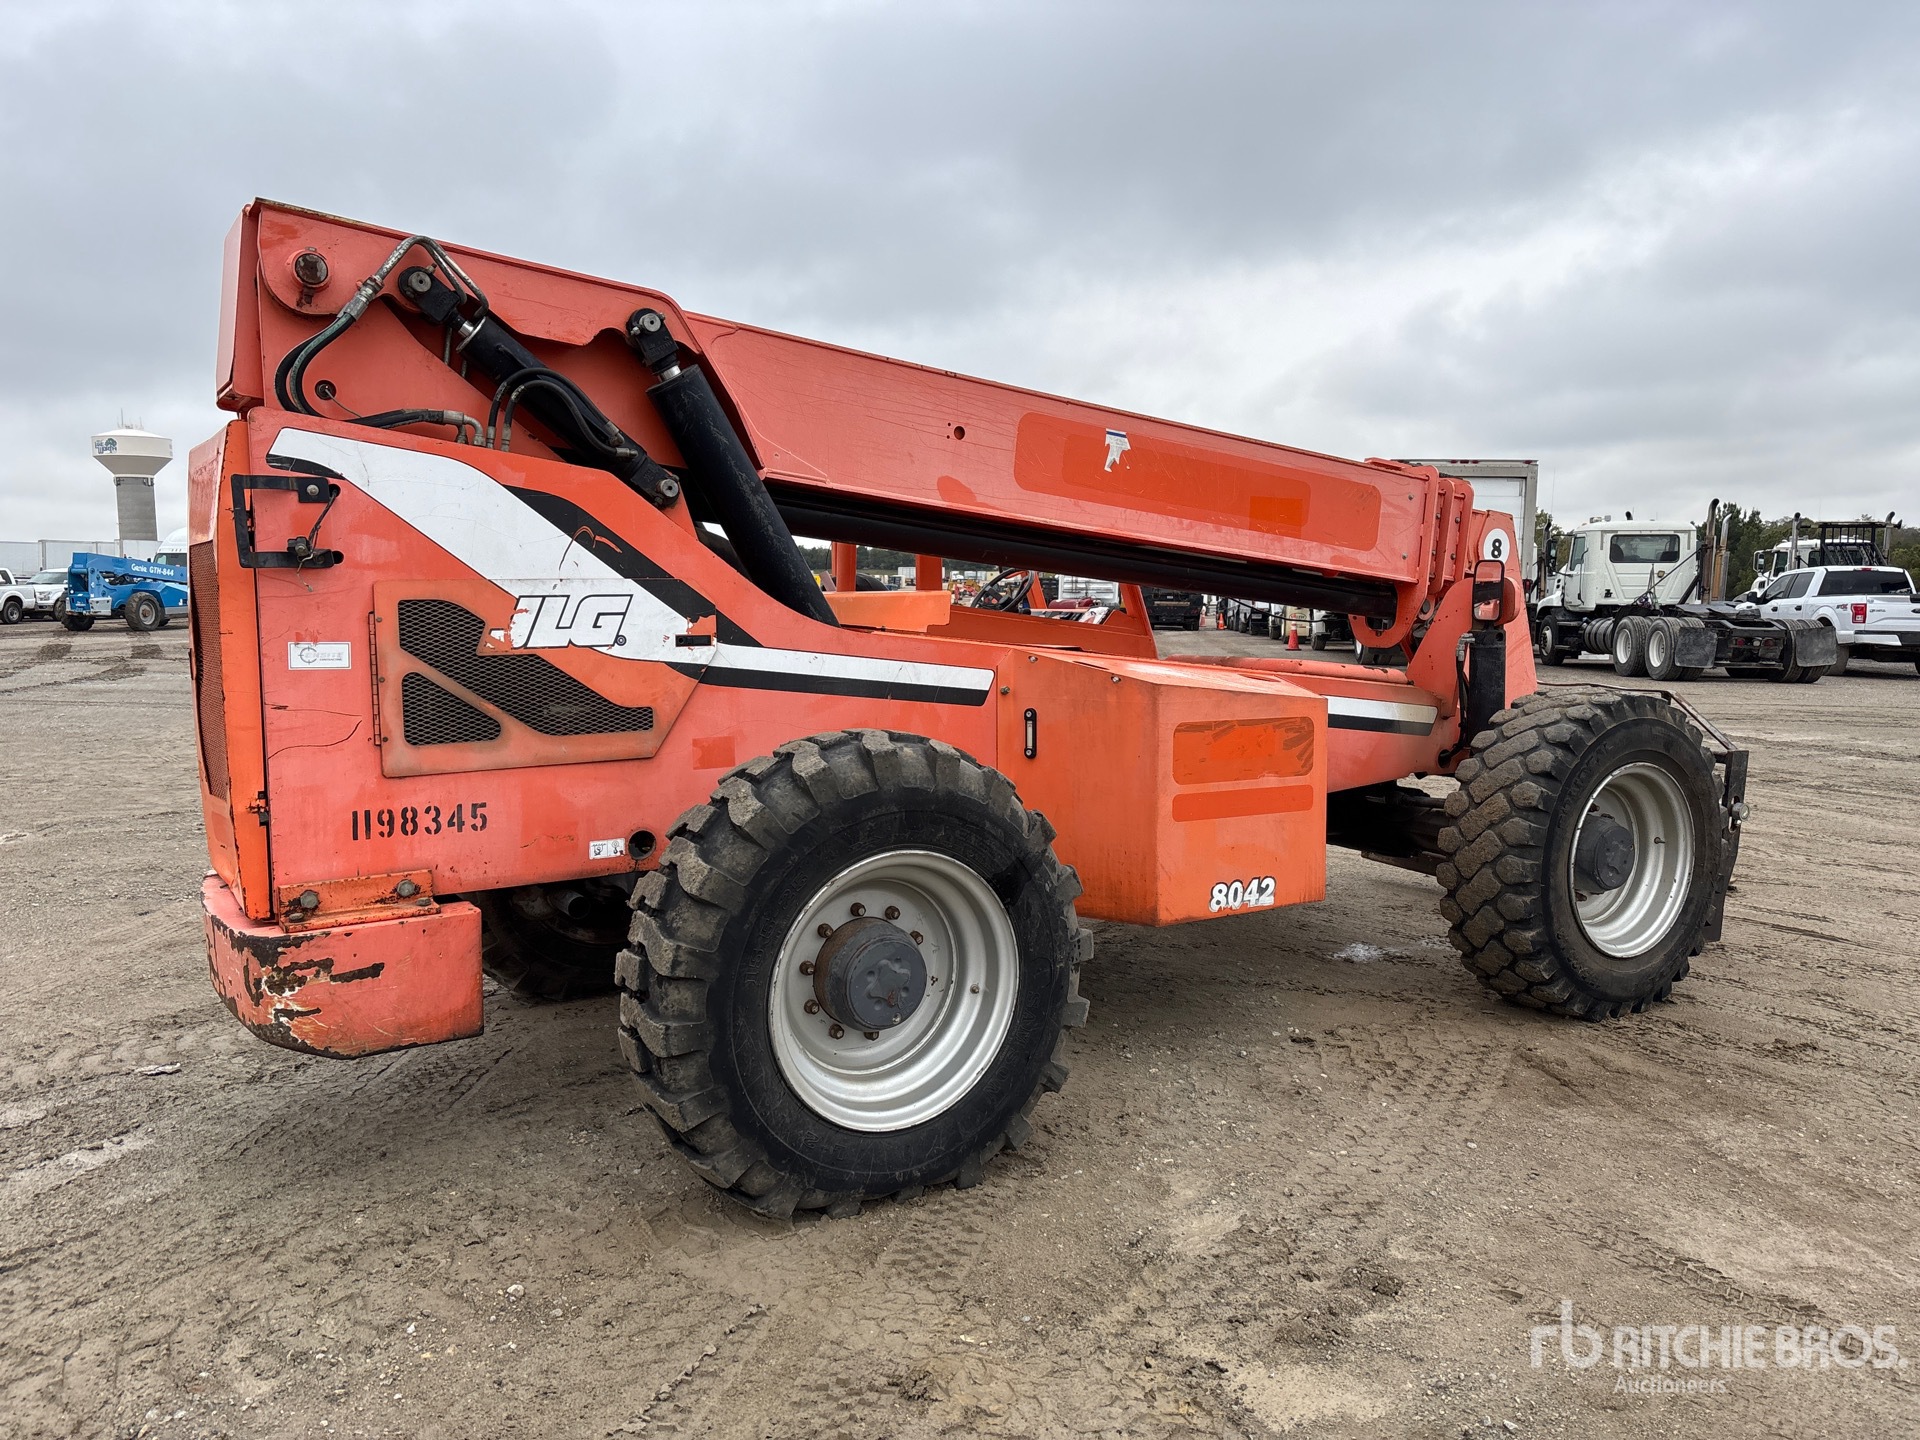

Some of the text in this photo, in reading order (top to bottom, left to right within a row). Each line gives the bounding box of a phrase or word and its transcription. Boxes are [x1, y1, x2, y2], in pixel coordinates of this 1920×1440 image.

[1491, 538, 1502, 559] 8
[131, 563, 174, 577] Genie GTH-844
[352, 802, 488, 841] 1198345
[1209, 875, 1277, 914] 8042
[983, 990, 1041, 1095] SAMSON
